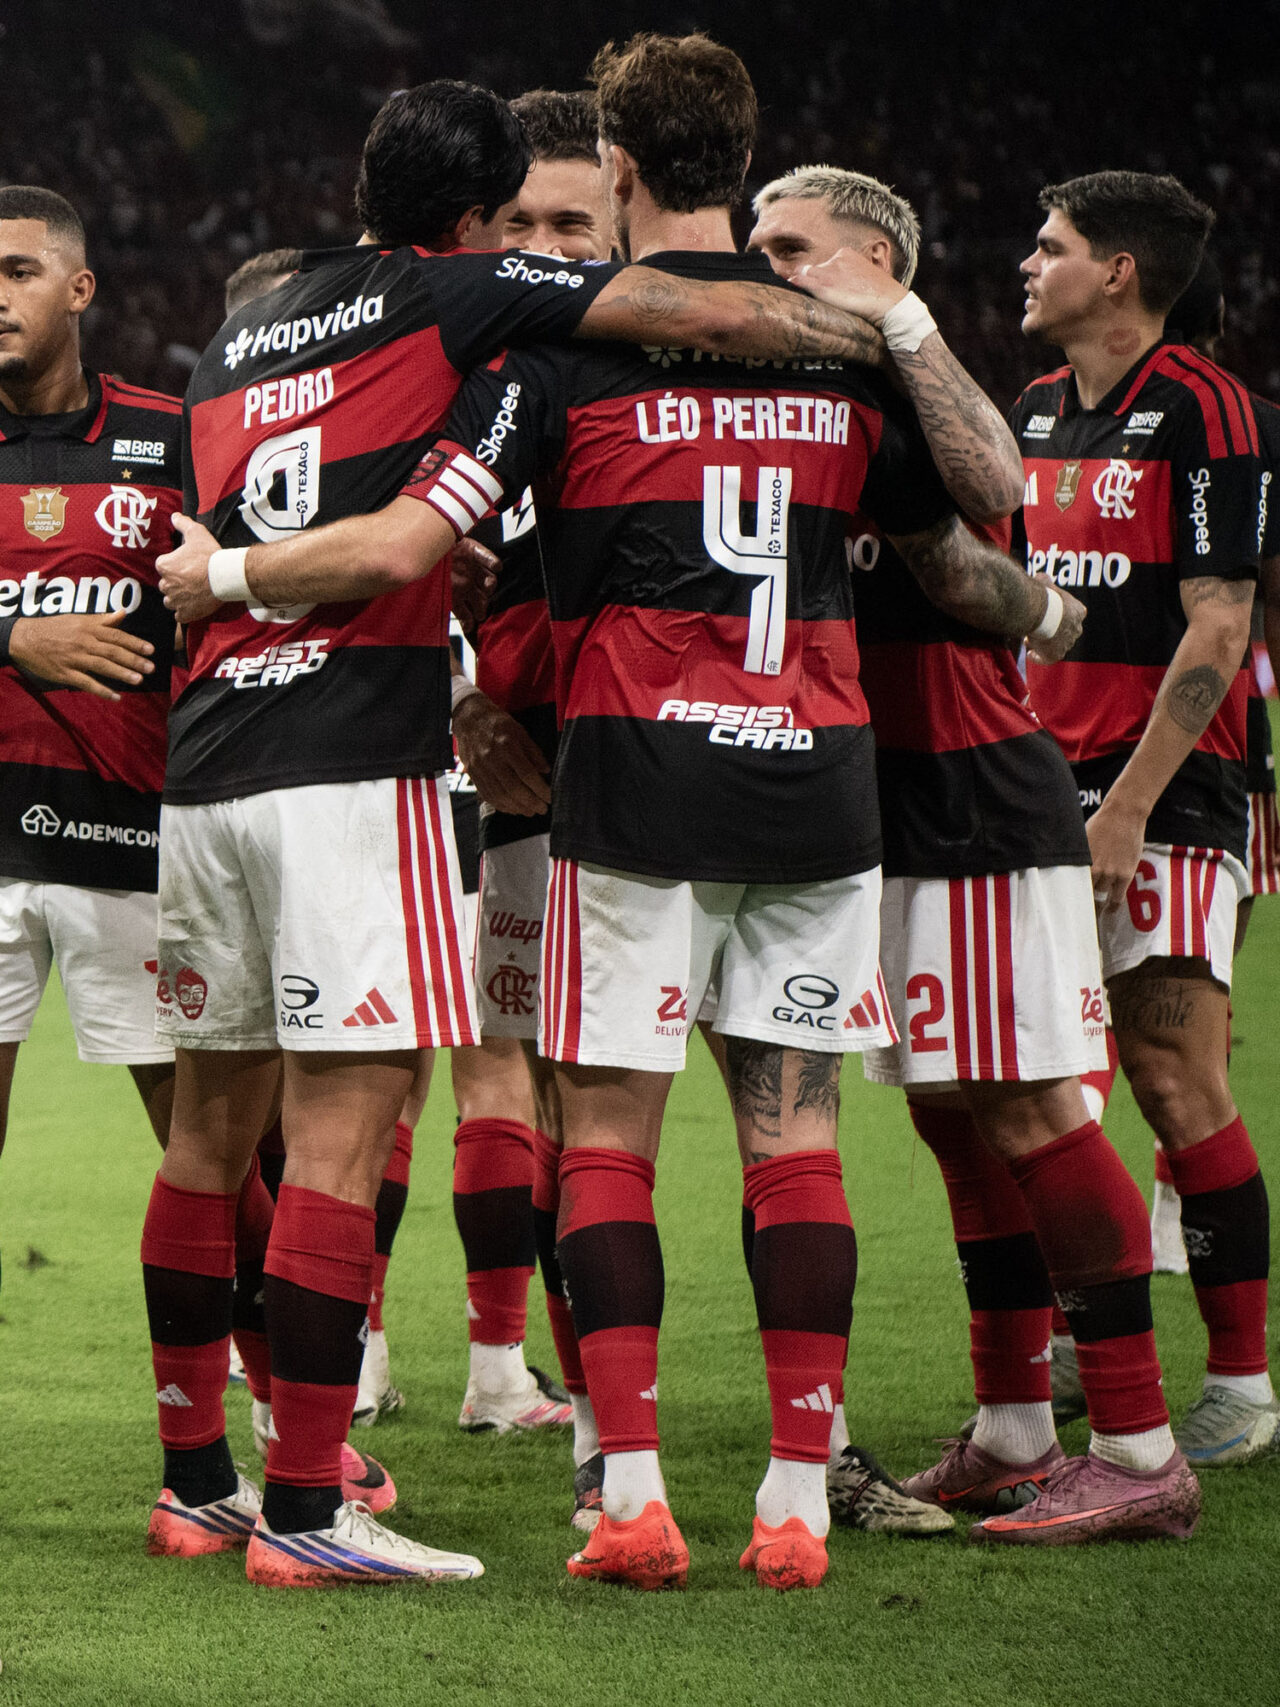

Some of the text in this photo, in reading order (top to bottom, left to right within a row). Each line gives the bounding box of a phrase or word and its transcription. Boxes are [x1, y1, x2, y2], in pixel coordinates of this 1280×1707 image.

[250, 294, 384, 358] Hapvida
[244, 367, 335, 429] PEDRO
[476, 381, 521, 466] Shopee
[636, 391, 851, 445] LÉO PEREIRA
[131, 440, 165, 458] BRB
[299, 441, 309, 495] TEXACO
[771, 478, 782, 535] TEXACO
[1188, 467, 1211, 555] Shopee
[703, 465, 792, 676] 4
[708, 723, 814, 751] CARD
[489, 911, 543, 945] Wap
[772, 1006, 837, 1031] GAC
[907, 973, 949, 1054] 2
[1080, 986, 1104, 1024] Zé
